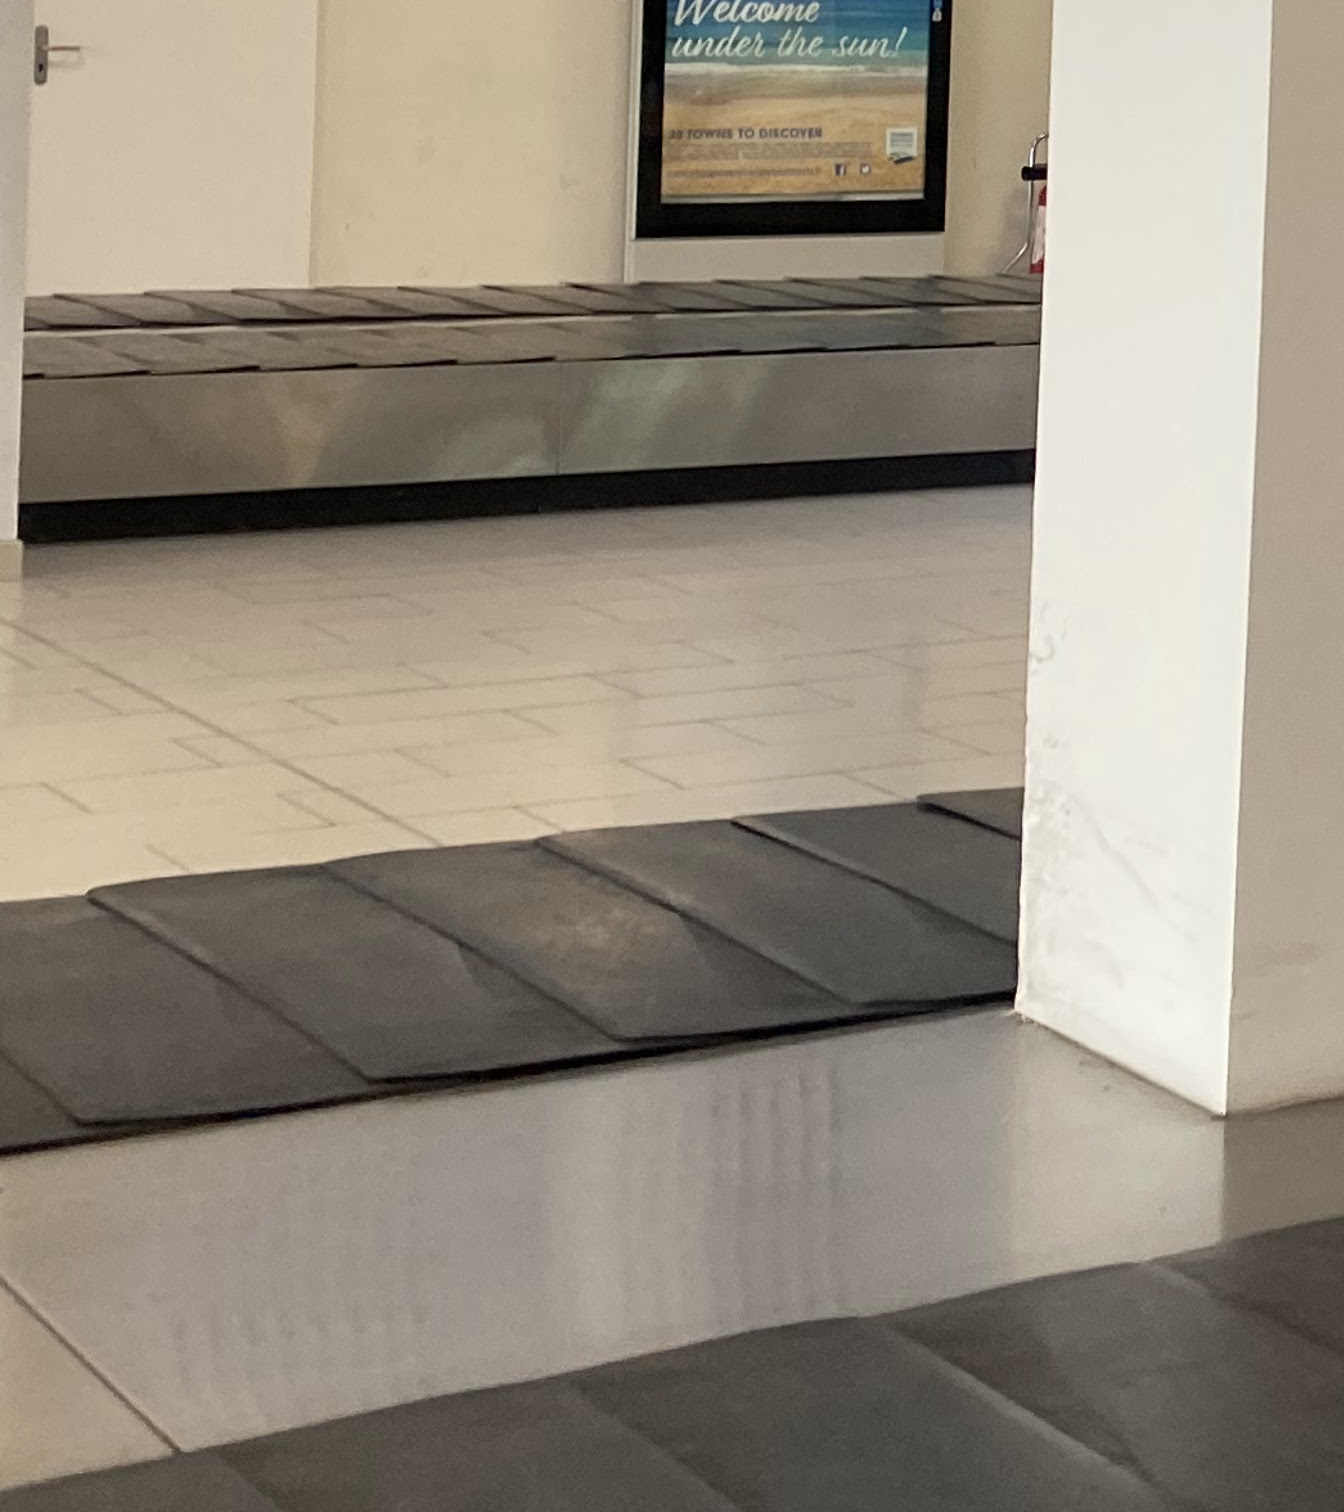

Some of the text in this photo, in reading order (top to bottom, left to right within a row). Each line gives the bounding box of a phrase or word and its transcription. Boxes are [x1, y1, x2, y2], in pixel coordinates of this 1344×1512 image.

[671, 25, 908, 58] under the sun!
[687, 128, 733, 140] TOWNS
[738, 127, 755, 139] TO
[759, 126, 823, 139] DISCOVER
